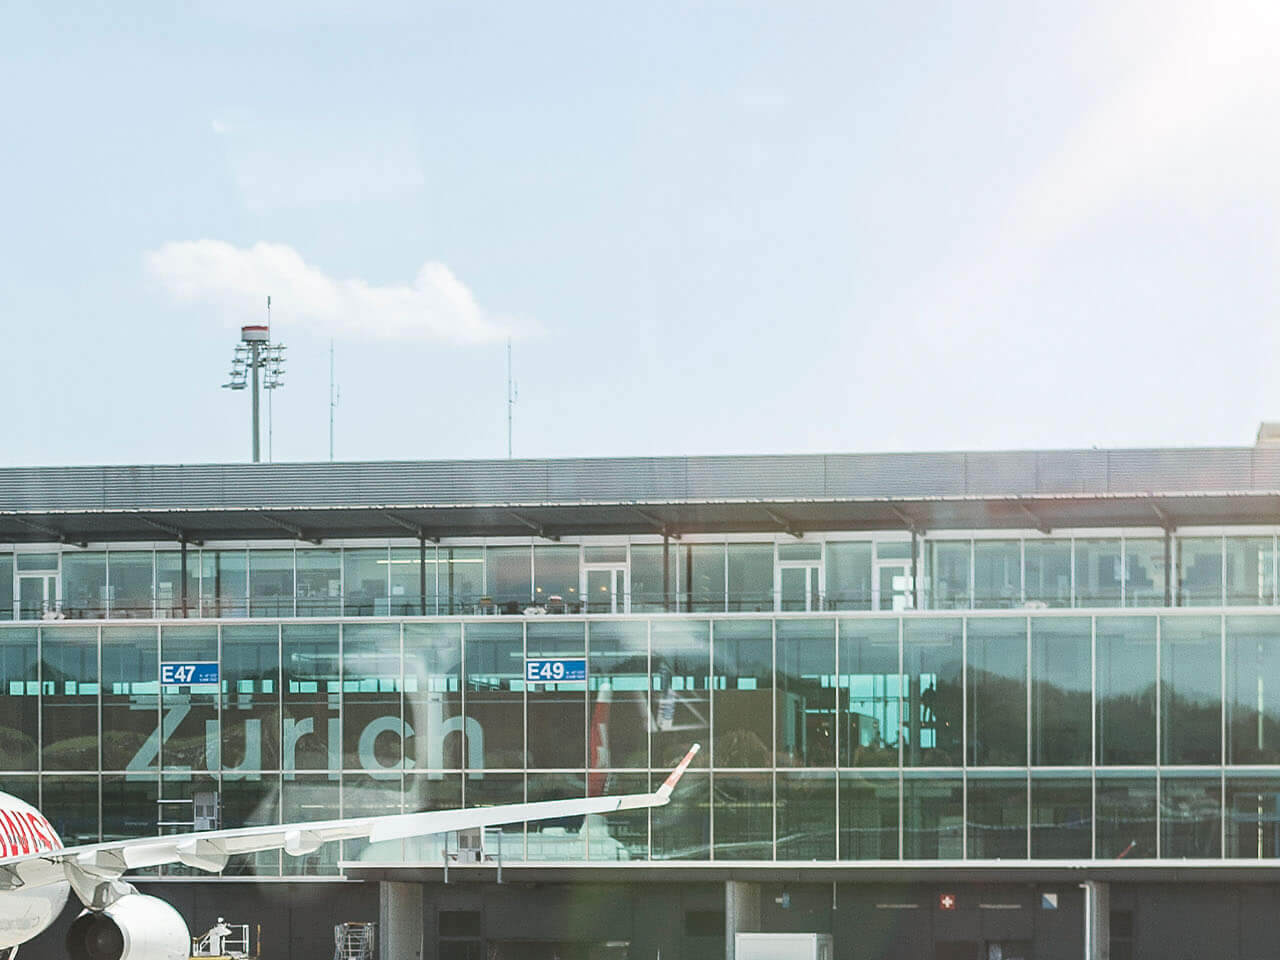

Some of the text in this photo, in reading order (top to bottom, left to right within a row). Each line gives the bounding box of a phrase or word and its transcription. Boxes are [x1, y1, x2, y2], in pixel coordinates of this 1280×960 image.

[162, 665, 196, 682] E47
[527, 662, 564, 679] E49
[125, 694, 485, 782] Zürich
